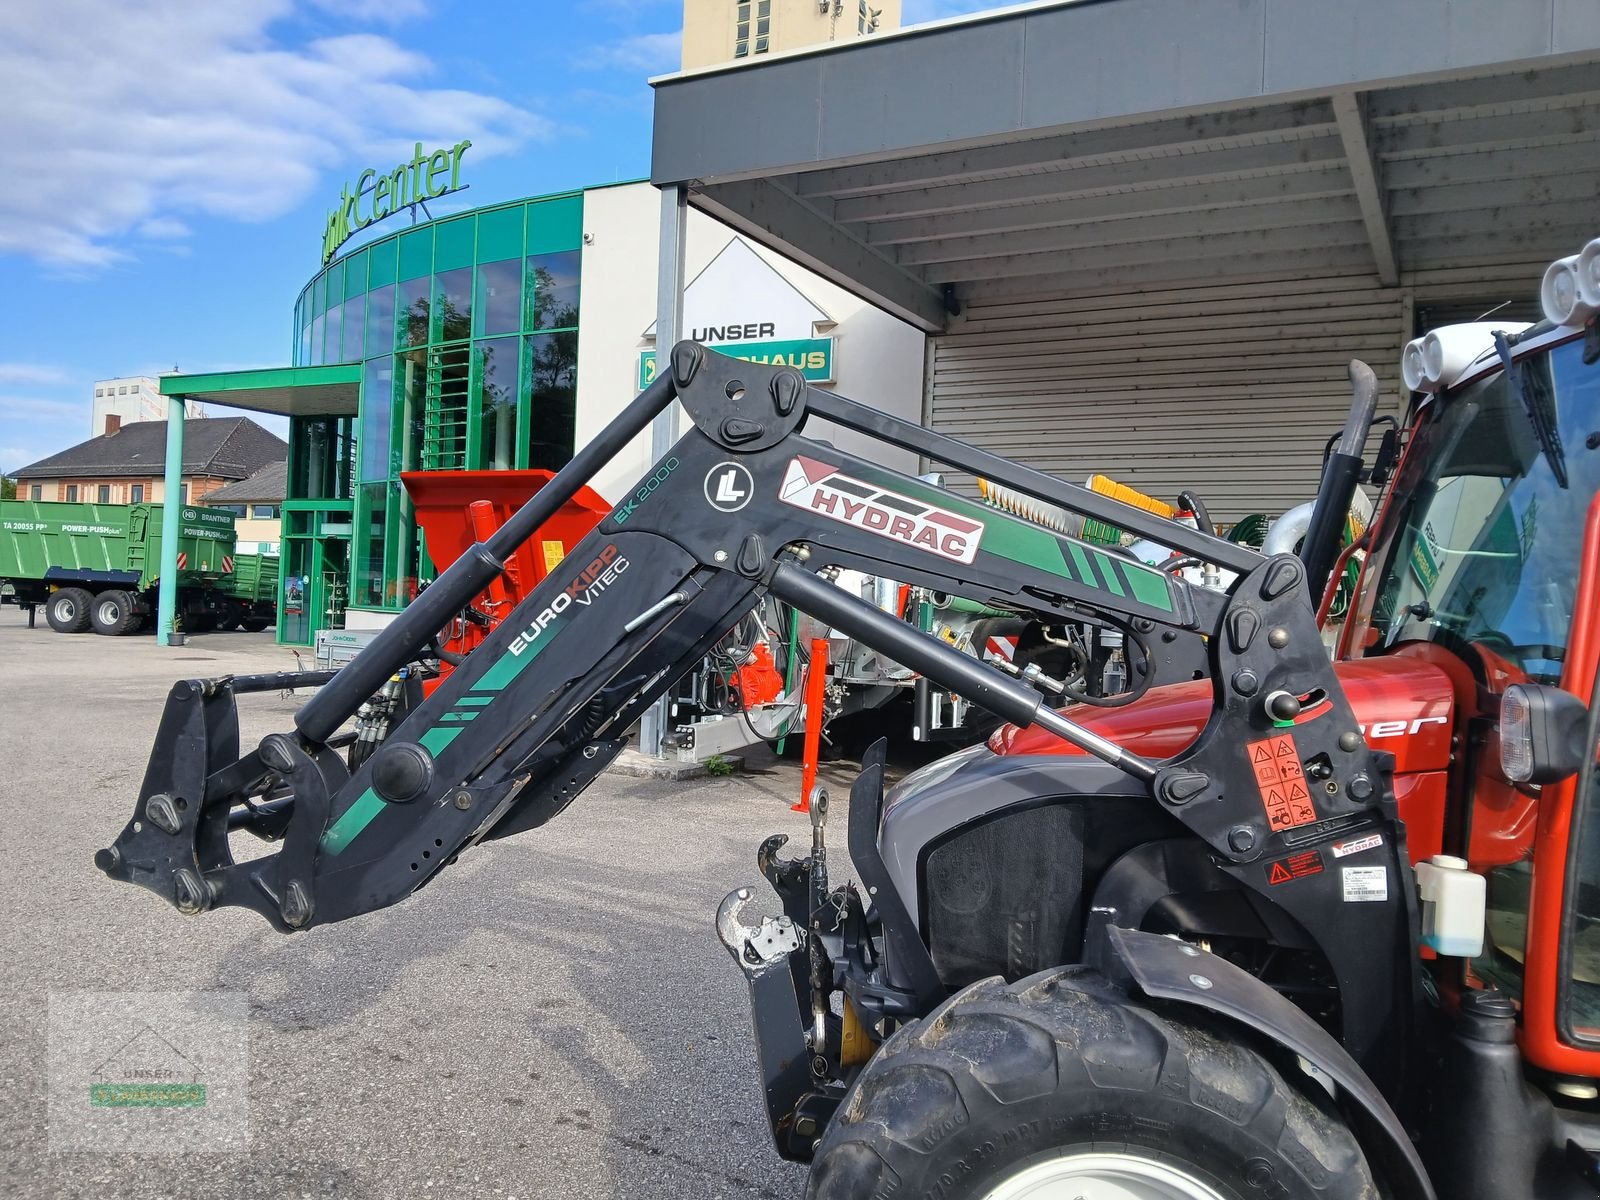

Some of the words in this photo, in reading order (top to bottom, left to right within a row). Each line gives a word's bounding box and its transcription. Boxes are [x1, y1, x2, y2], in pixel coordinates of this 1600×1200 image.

[692, 322, 775, 342] UNSER
[614, 499, 639, 525] EK
[636, 456, 681, 502] 2000
[201, 513, 231, 524] BRANTNER
[811, 488, 967, 557] HYDRAC
[507, 543, 618, 657] EUROKIPP
[1342, 839, 1380, 855] HYDRAC
